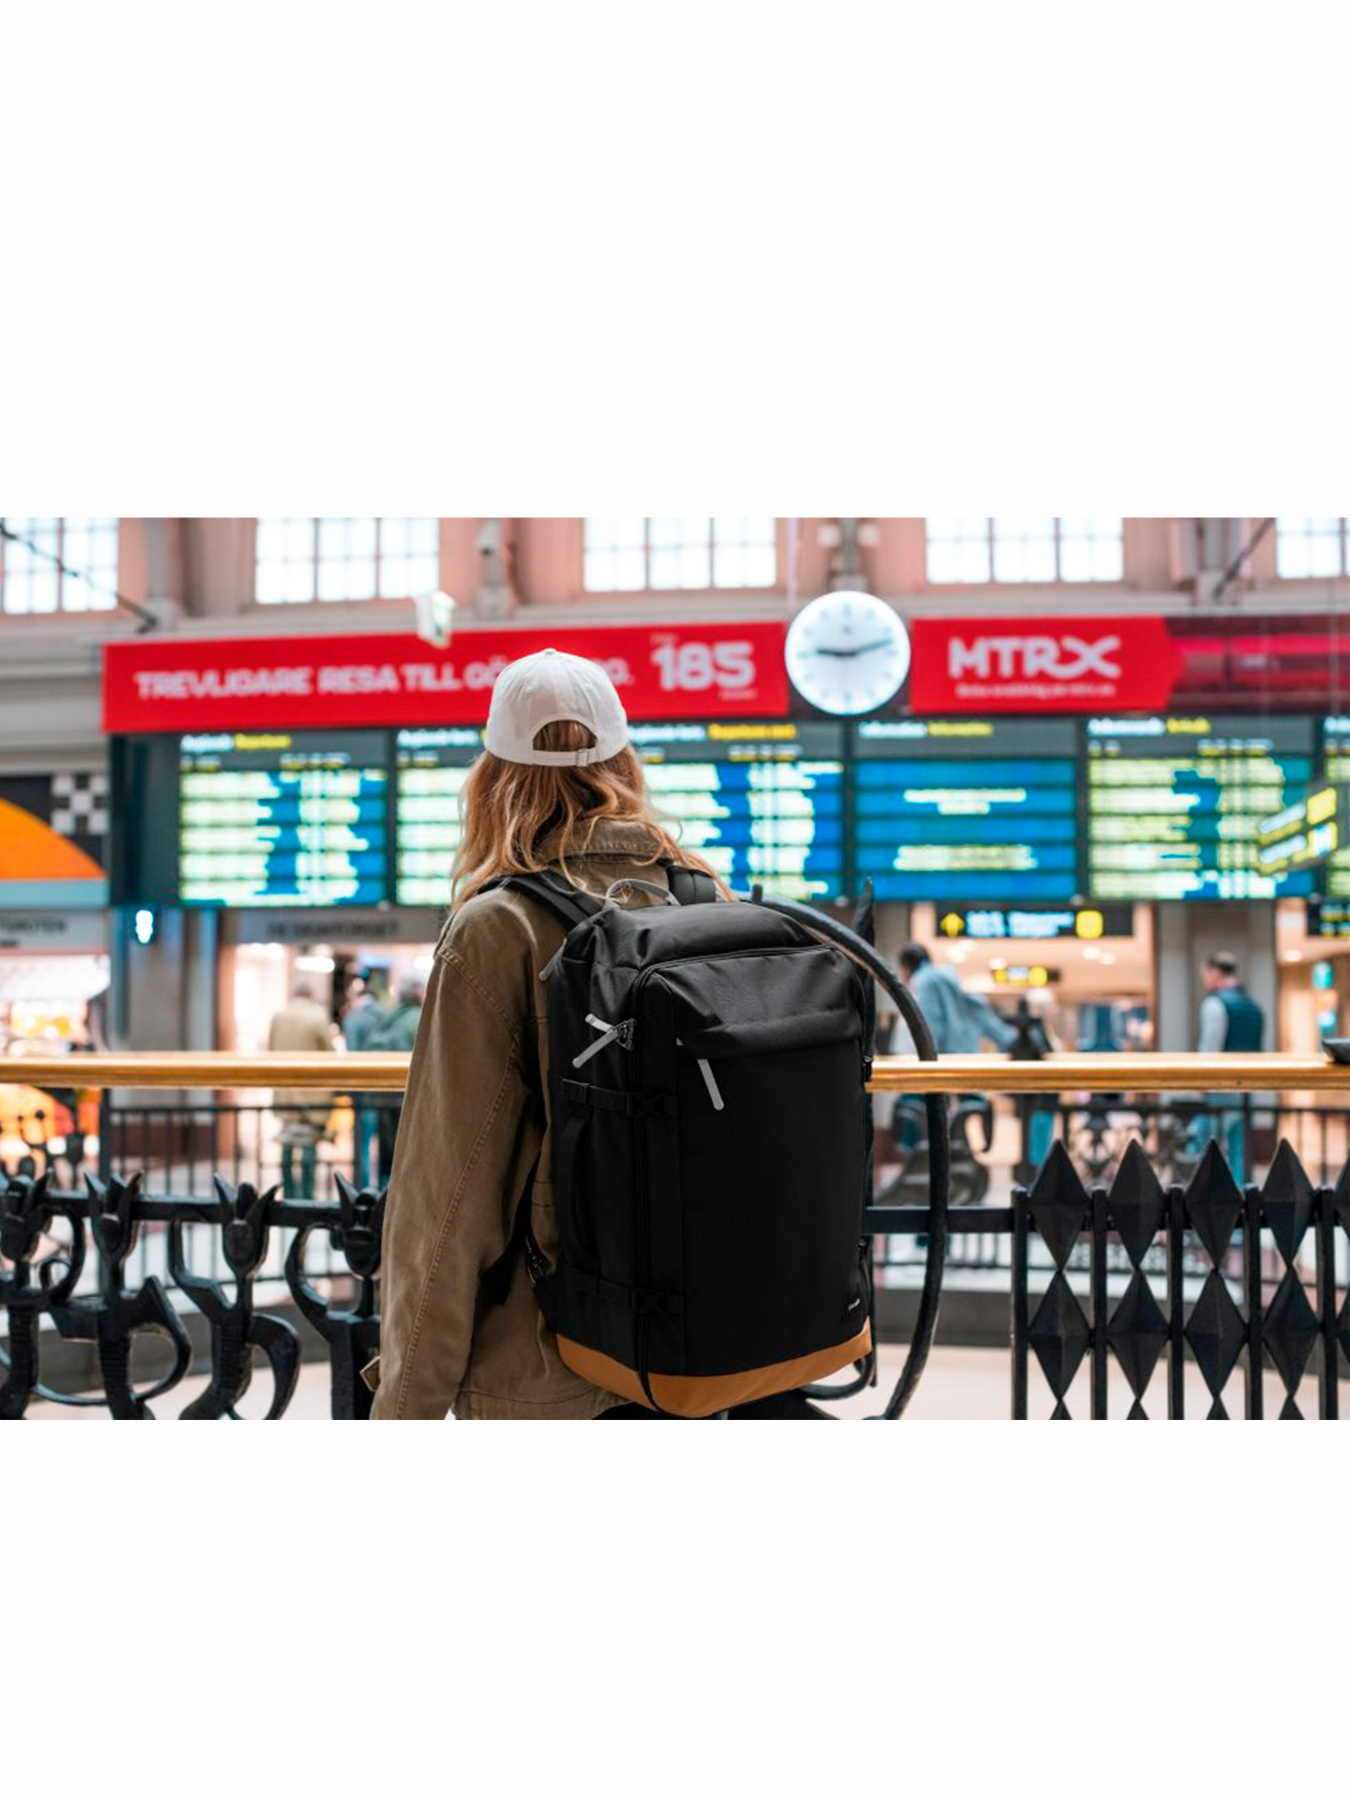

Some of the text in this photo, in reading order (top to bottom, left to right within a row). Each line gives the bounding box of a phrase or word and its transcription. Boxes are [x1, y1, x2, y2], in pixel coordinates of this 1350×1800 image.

[318, 665, 399, 694] RESA
[402, 663, 461, 691] TILL
[652, 641, 756, 691] 185
[949, 635, 1121, 679] MTRX
